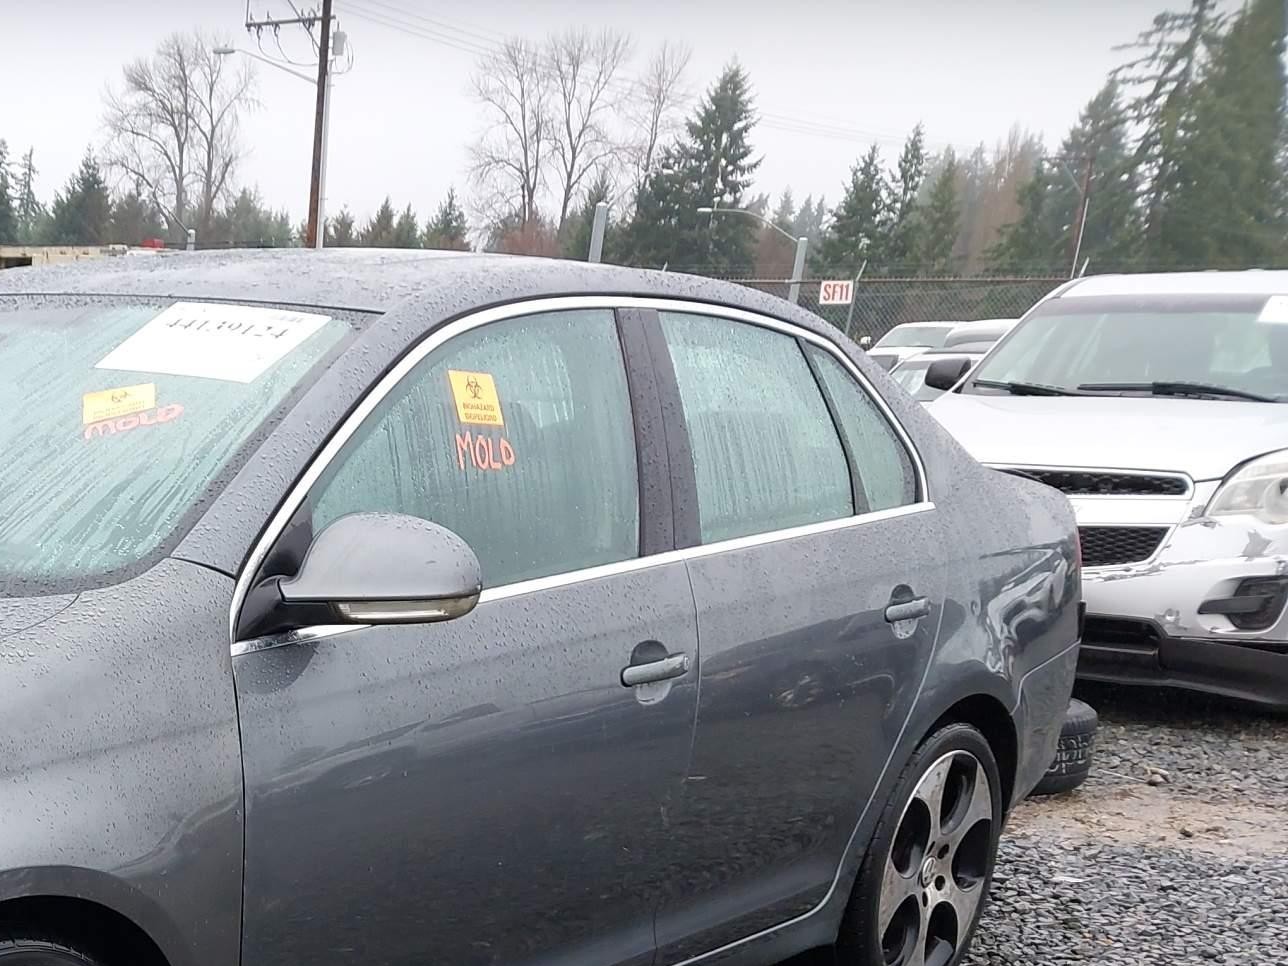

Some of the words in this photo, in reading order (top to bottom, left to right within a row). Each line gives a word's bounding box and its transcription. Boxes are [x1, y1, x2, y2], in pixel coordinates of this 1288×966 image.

[823, 283, 850, 301] SF11
[83, 403, 185, 440] MOLD
[455, 431, 516, 470] MOLD
